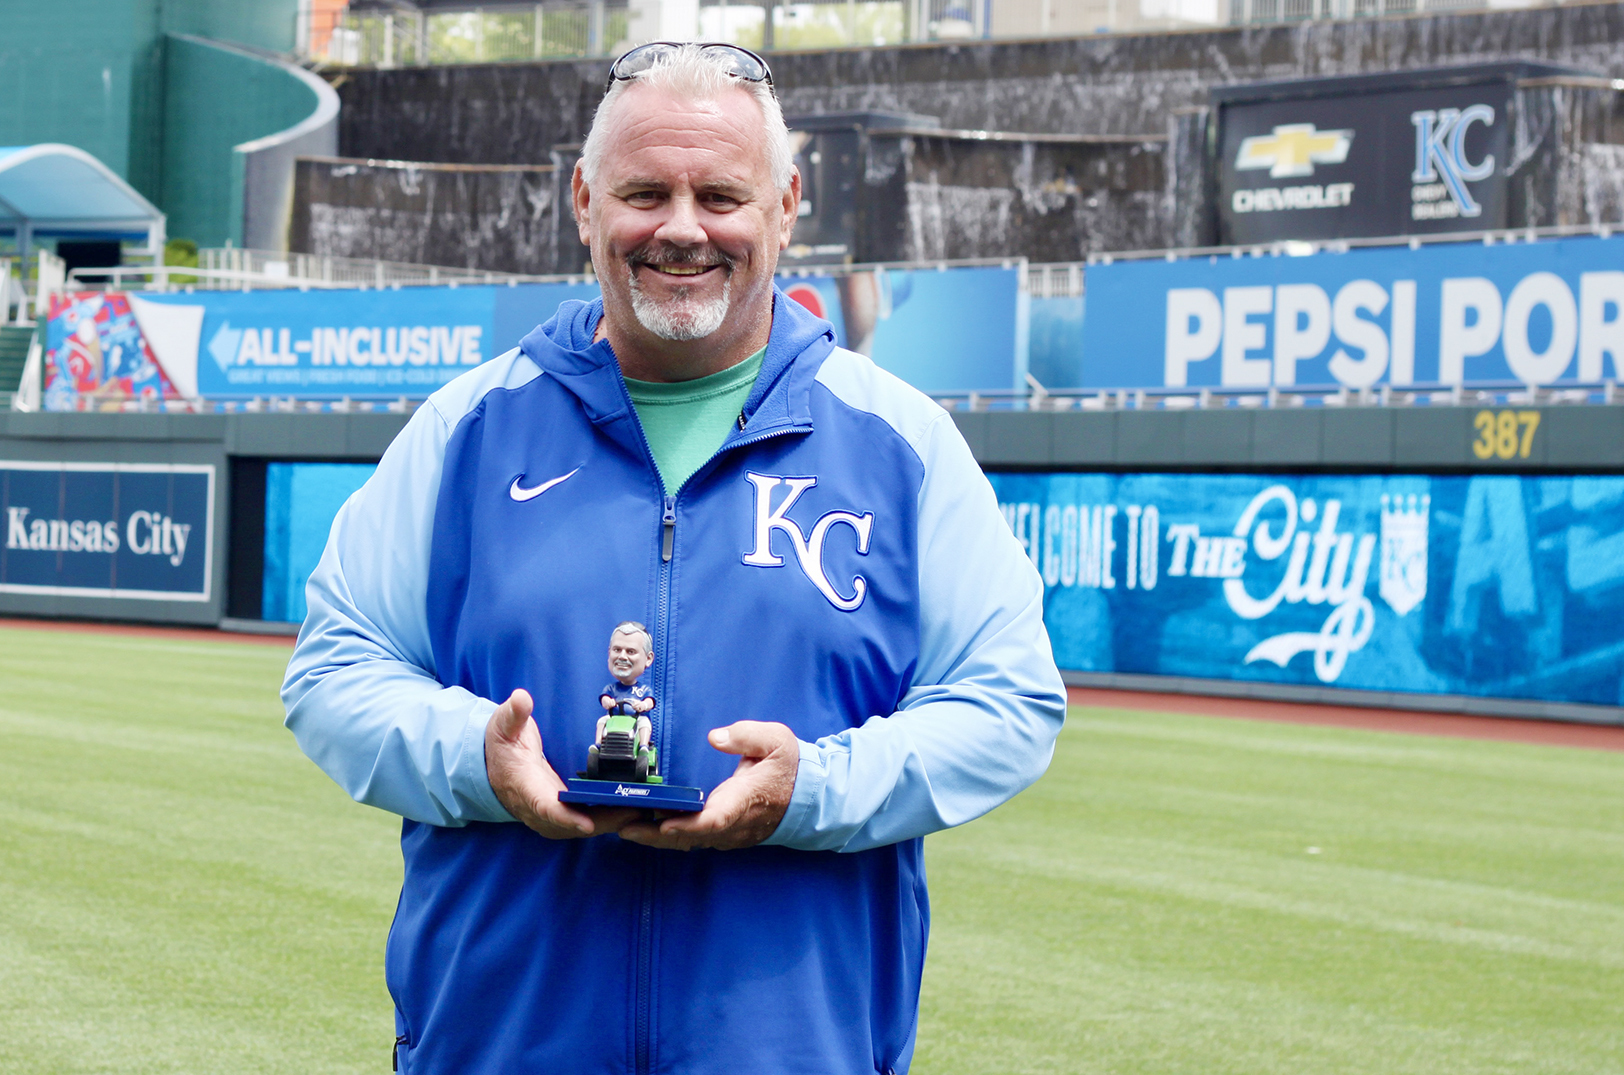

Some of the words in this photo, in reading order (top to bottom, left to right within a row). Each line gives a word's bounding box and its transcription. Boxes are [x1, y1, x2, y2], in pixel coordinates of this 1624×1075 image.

[1232, 182, 1355, 213] CHEVROLET
[1411, 104, 1495, 218] KC
[236, 326, 483, 366] ALL-INCLUSIVE
[1164, 280, 1417, 388] PEPSI
[1473, 409, 1541, 460] 387
[6, 506, 120, 554] Kansas
[126, 510, 191, 567] City
[741, 470, 876, 612] KC
[1126, 504, 1159, 591] TO
[1223, 485, 1378, 683] City
